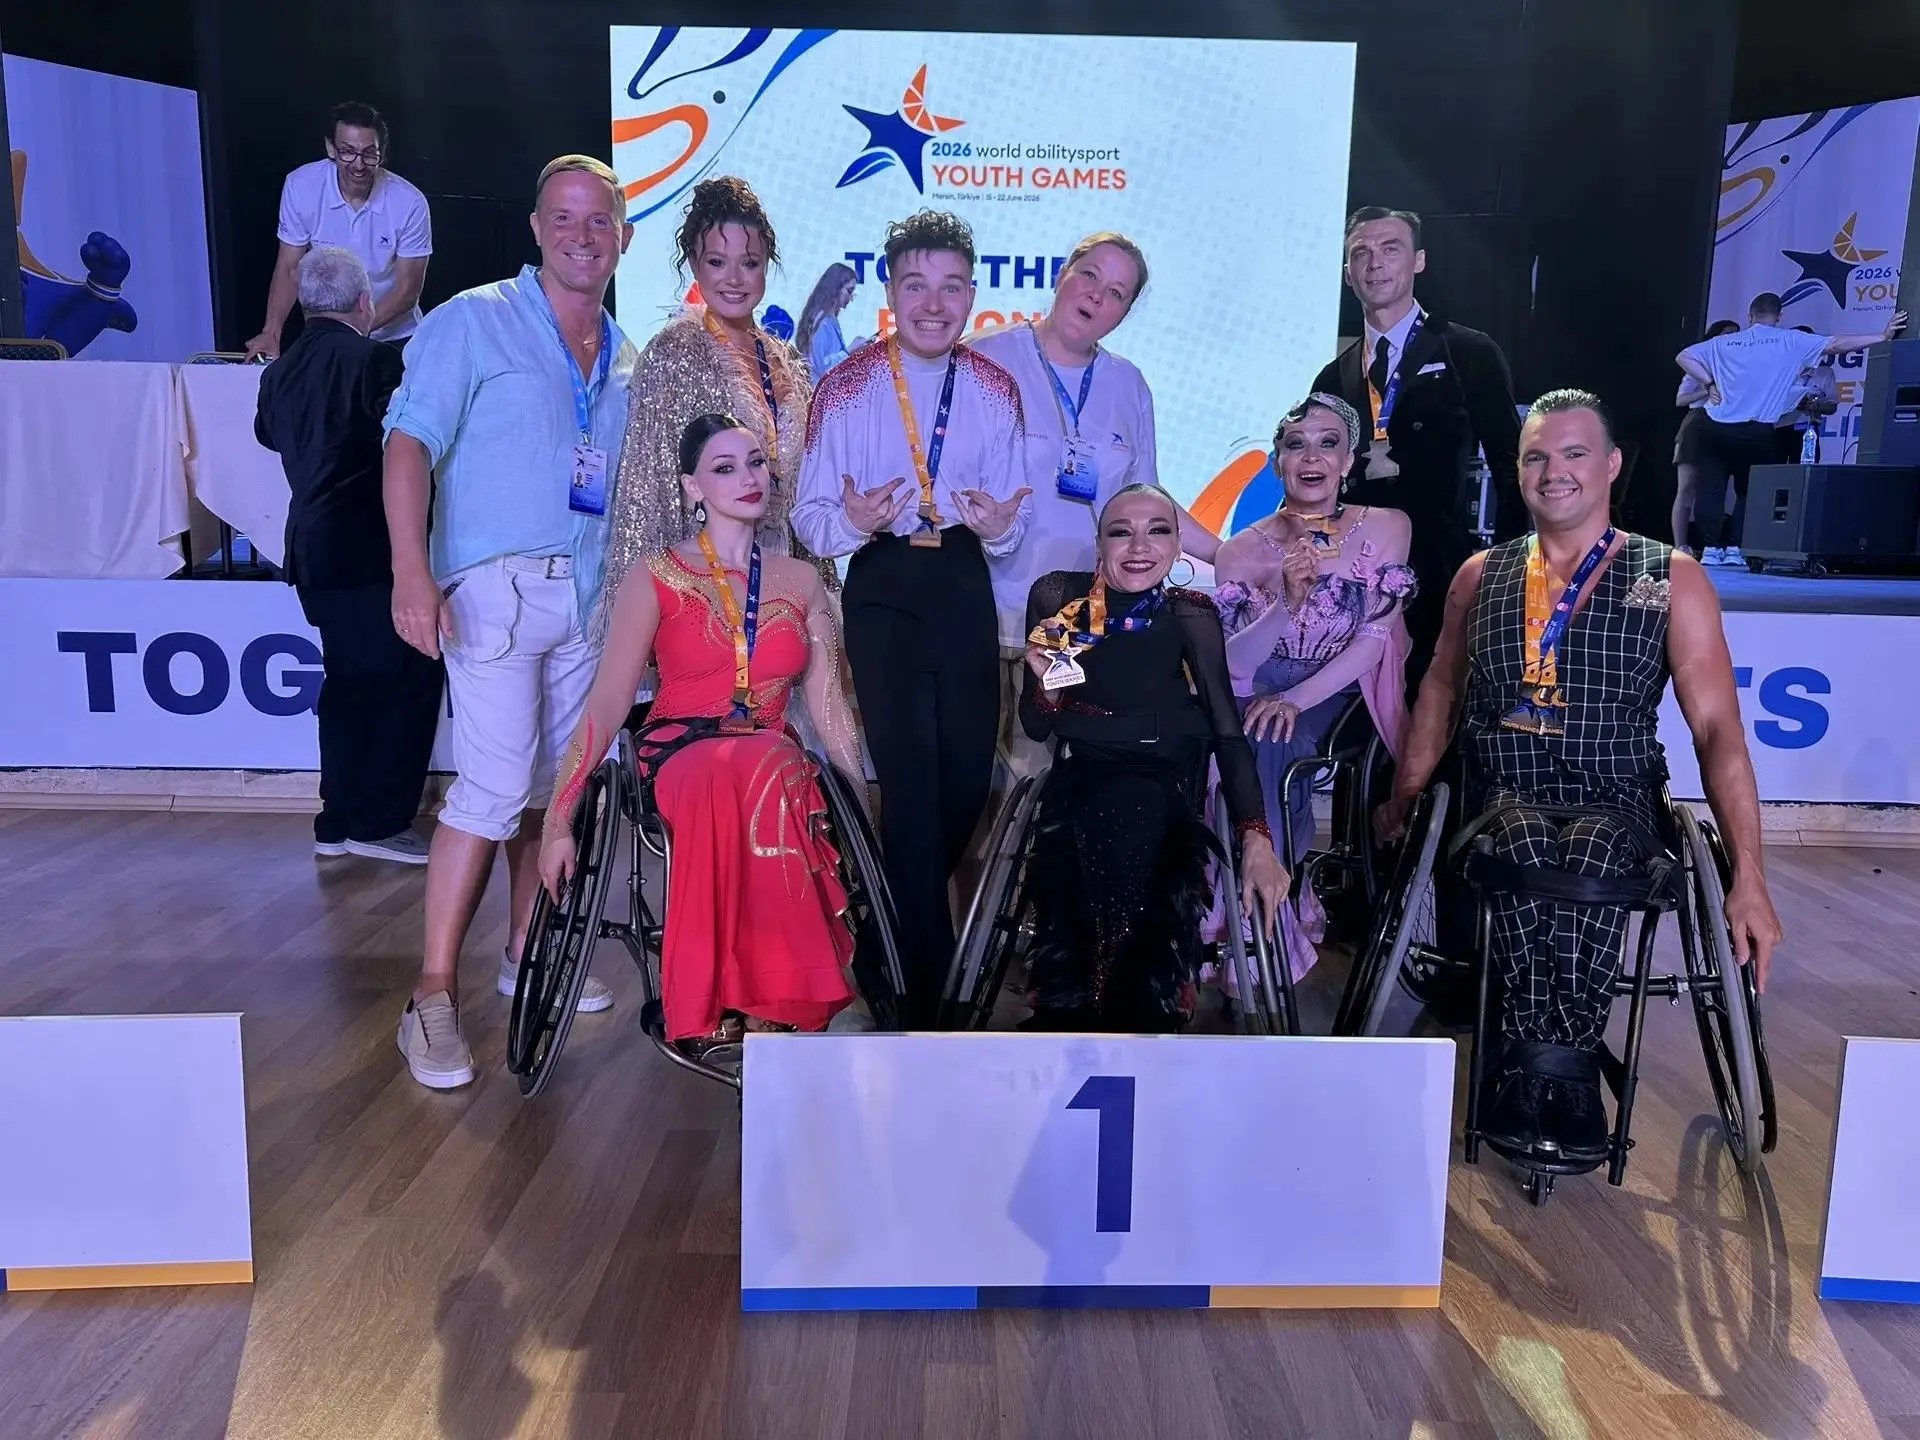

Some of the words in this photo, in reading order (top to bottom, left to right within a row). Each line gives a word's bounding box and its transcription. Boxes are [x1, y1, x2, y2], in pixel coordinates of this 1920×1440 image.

[931, 142, 972, 157] 2026
[976, 143, 1021, 158] world
[1025, 144, 1120, 163] abilitysport
[931, 165, 1023, 188] YOUTH
[1031, 167, 1127, 190] GAMES
[1855, 266, 1892, 281] 2026
[57, 631, 324, 716] TOG
[1065, 1076, 1135, 1232] 1
